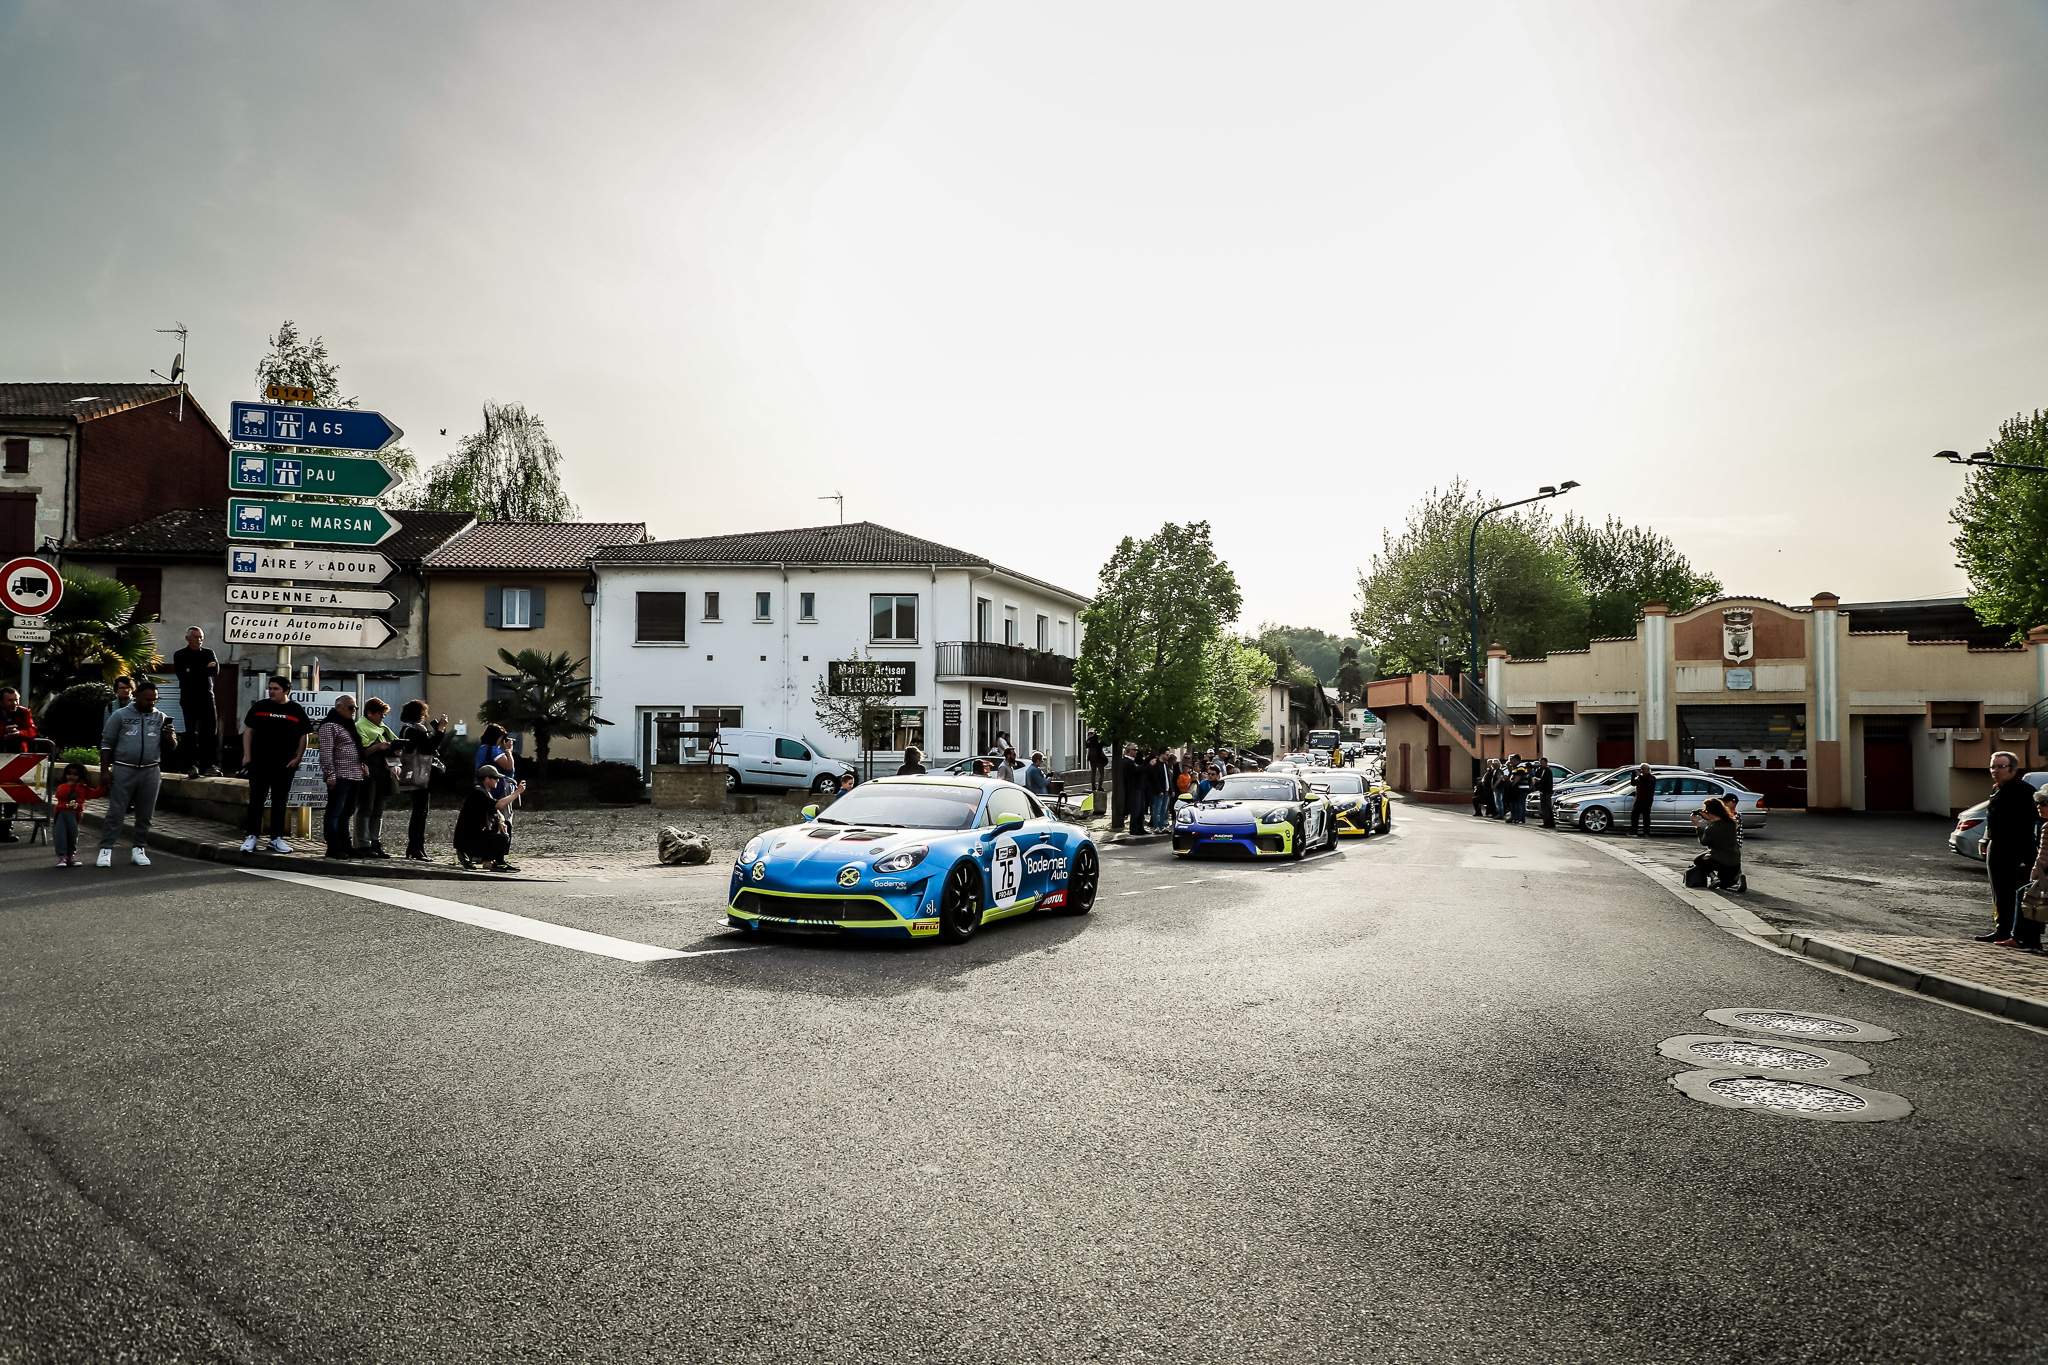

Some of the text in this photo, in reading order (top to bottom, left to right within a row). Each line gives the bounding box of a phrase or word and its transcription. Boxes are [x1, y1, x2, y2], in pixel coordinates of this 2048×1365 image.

[271, 387, 309, 398] D 147
[308, 423, 343, 435] A 65
[306, 469, 336, 481] PAU
[291, 519, 304, 528] DE
[311, 516, 372, 532] MARSAN
[261, 560, 297, 570] AIRE
[231, 589, 313, 603] CAUPENNE
[230, 615, 363, 631] Circuit Automobile
[229, 629, 312, 643] Mécanopôle
[874, 664, 906, 675] Artisan
[841, 677, 902, 693] FLEURISTE
[289, 692, 318, 702] CUIT
[304, 706, 328, 716] OBIL
[884, 786, 962, 795] CERTINA
[1027, 856, 1067, 875] Bodemer
[1000, 860, 1014, 889] 76
[1051, 869, 1069, 880] Auto
[912, 921, 940, 930] PIRELLI
